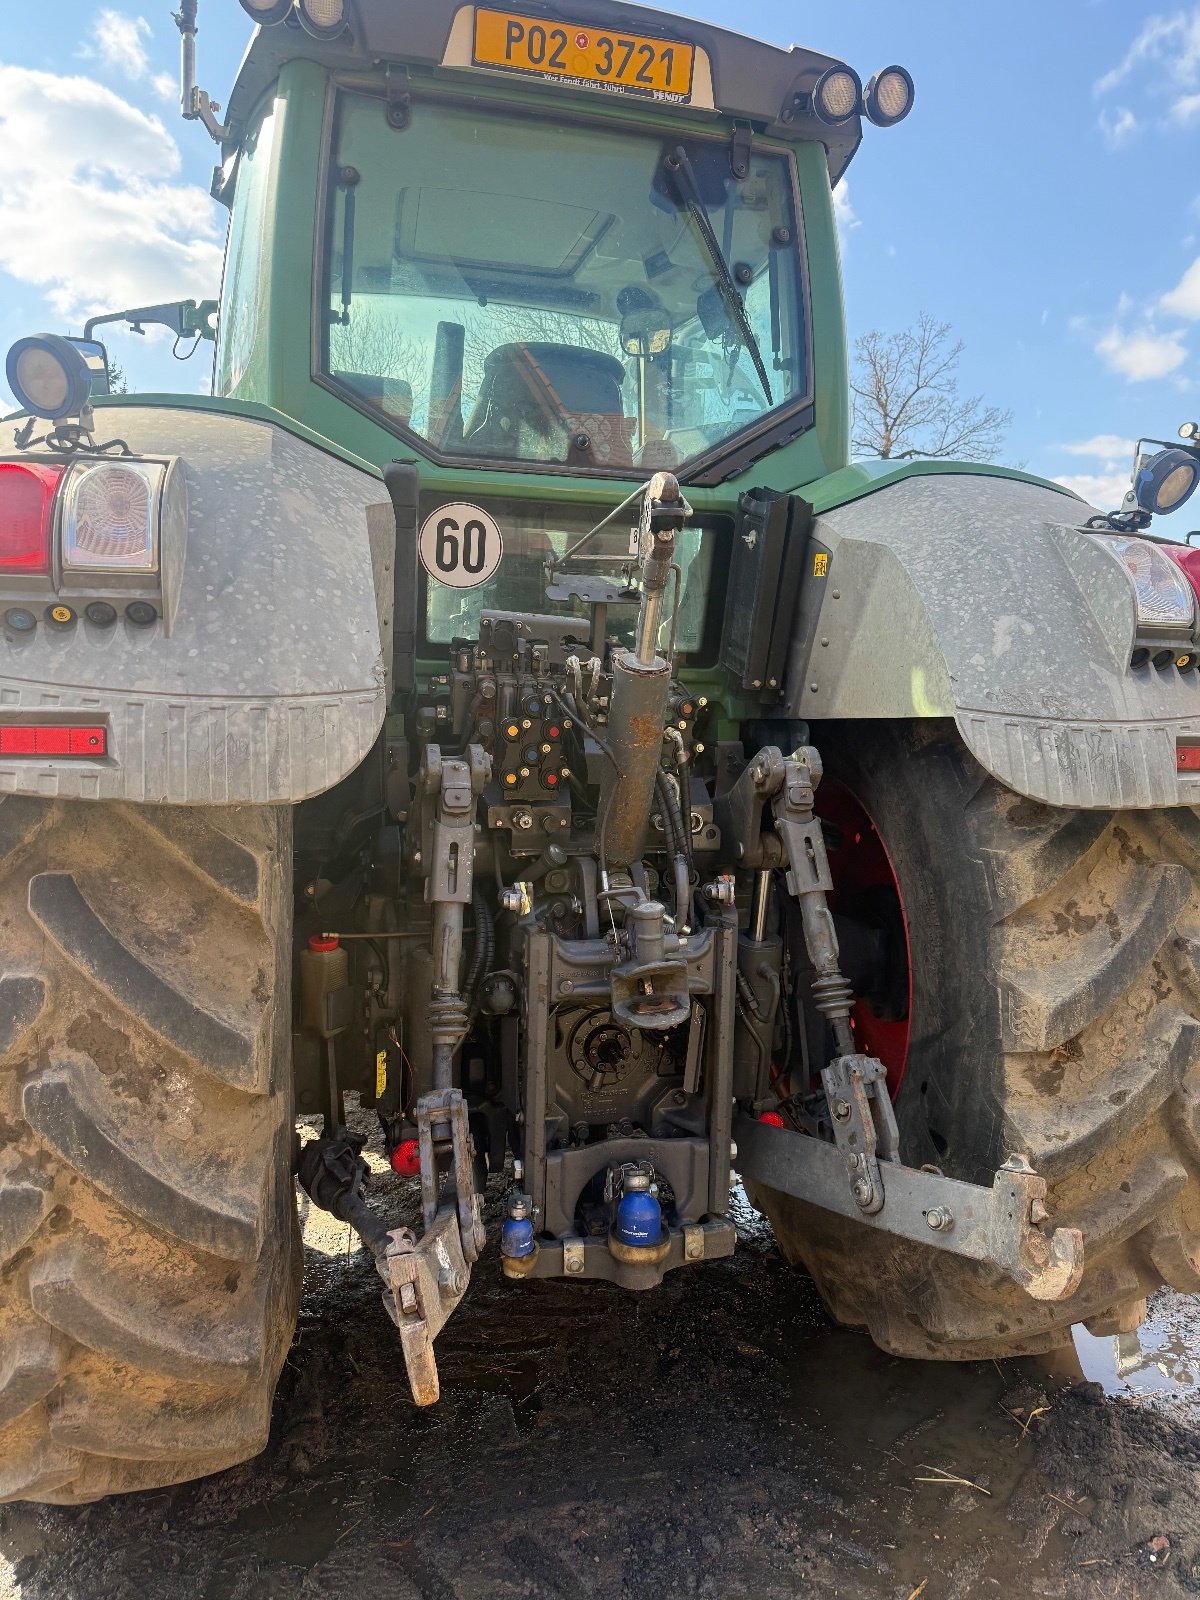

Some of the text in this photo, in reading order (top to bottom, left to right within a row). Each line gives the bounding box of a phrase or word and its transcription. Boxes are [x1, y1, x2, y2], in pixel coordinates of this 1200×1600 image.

[506, 20, 675, 86] P02 3721
[543, 73, 559, 81] Wer
[559, 76, 581, 86] Fendt
[653, 90, 685, 103] FENDT
[436, 517, 487, 574] 60
